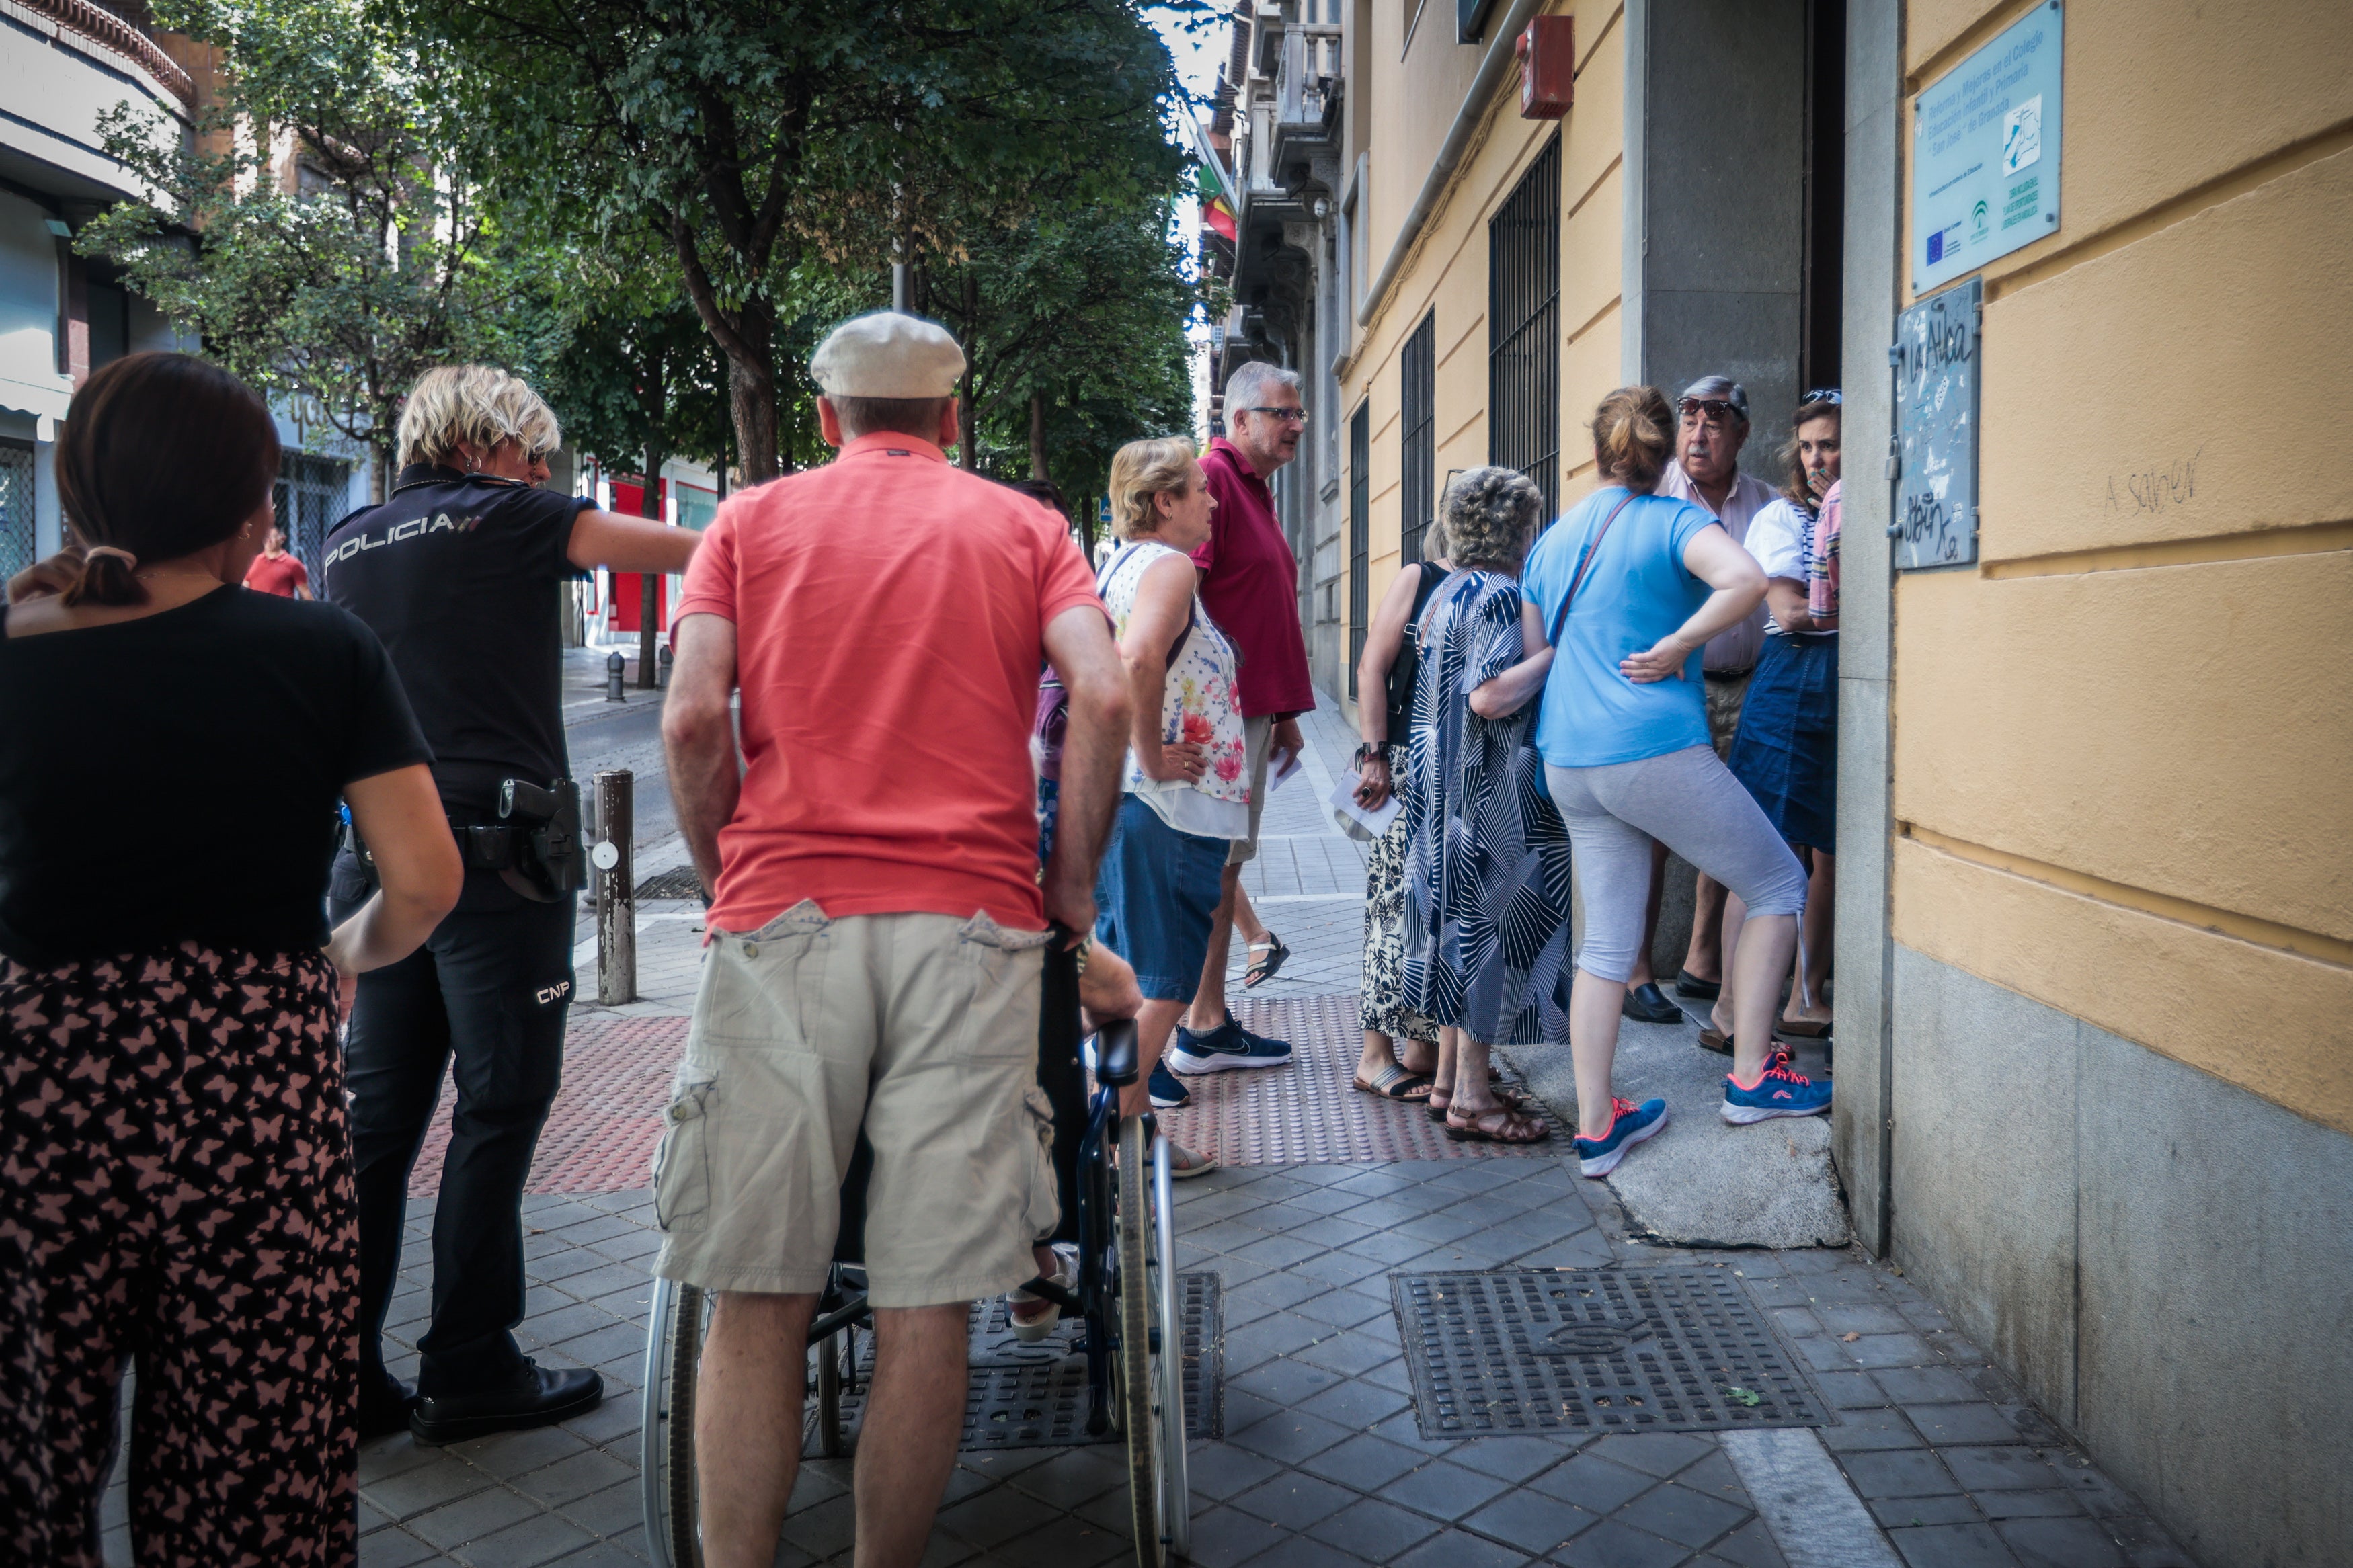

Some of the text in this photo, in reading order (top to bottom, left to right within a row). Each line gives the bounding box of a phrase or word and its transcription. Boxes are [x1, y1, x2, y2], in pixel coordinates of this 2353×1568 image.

[1929, 30, 2044, 121] Reforma y Mejoras en el Colegio
[1928, 109, 1962, 141] Educación
[1963, 87, 1988, 116] infantil
[1989, 86, 1995, 104] y
[1967, 116, 1977, 134] de
[1978, 97, 2009, 127] Granada
[325, 513, 455, 577] POLICIA
[536, 981, 570, 1004] CNP
